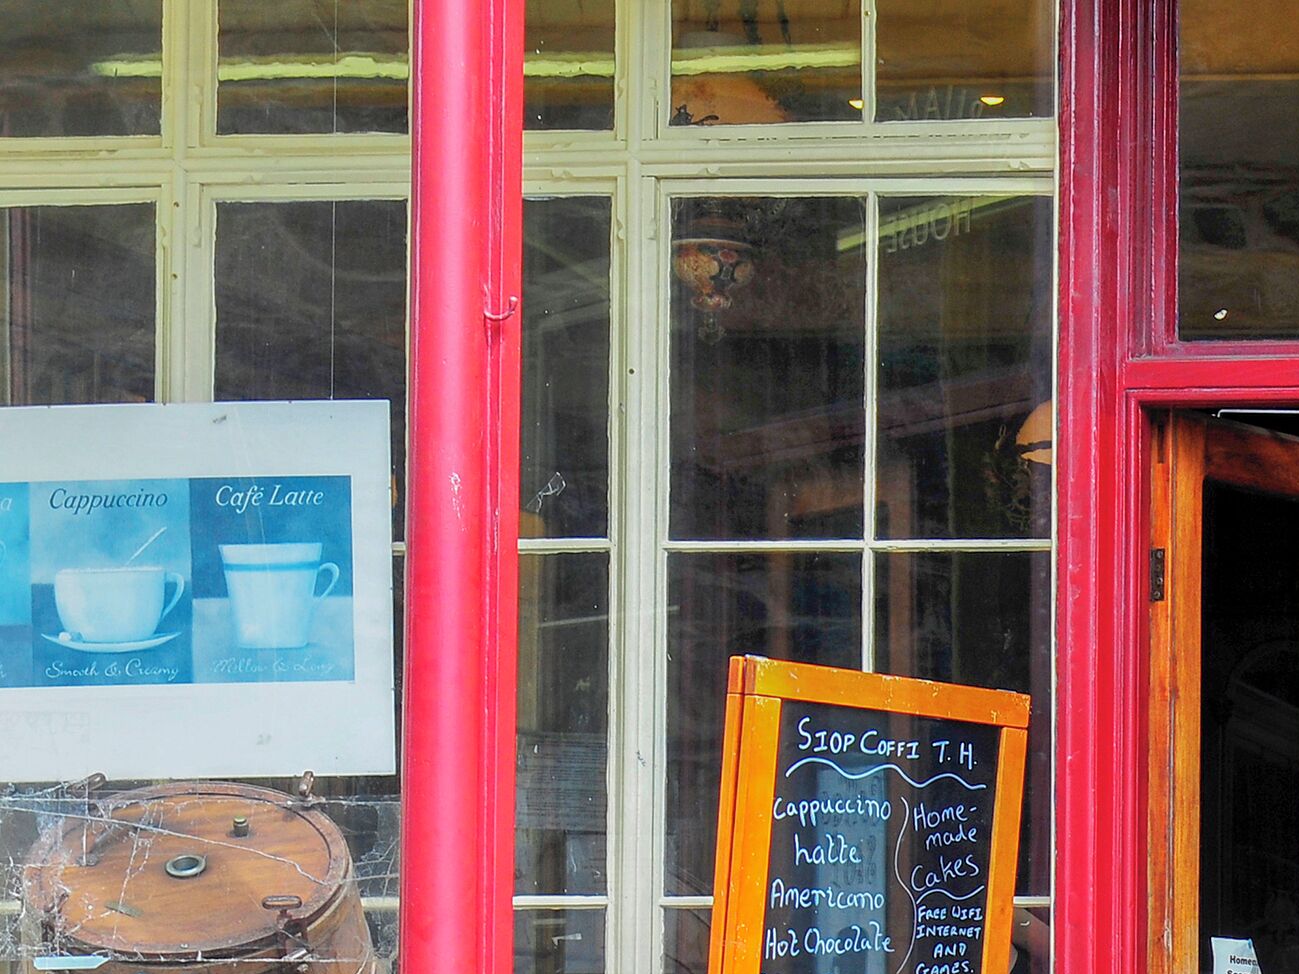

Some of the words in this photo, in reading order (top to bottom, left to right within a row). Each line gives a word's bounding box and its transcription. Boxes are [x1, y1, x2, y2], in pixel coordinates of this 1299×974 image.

[49, 487, 168, 515] Cappuccino
[215, 484, 264, 514] Café
[269, 484, 324, 506] Latte
[773, 794, 892, 828] Cappuccino
[926, 824, 978, 851] made
[911, 854, 980, 892] Cakes
[771, 878, 885, 911] Americano
[917, 905, 948, 923] FREE
[765, 927, 800, 961] Hot
[804, 920, 896, 956] Chocolate
[916, 924, 983, 940] INTERNET
[933, 943, 968, 959] AND
